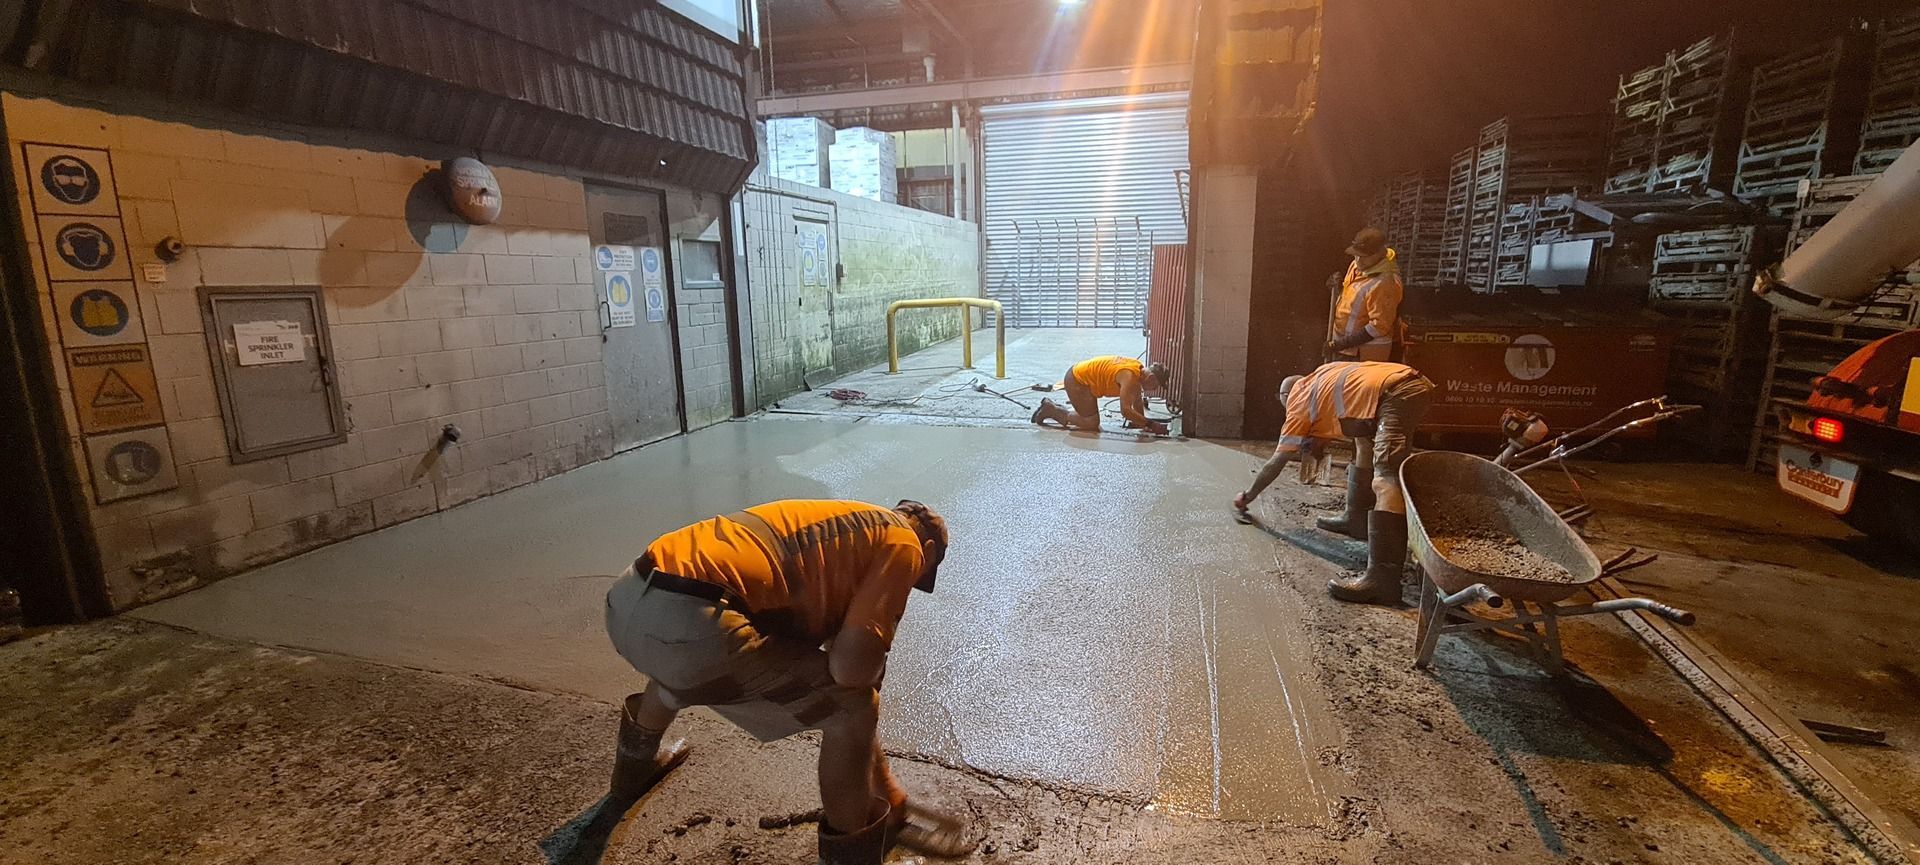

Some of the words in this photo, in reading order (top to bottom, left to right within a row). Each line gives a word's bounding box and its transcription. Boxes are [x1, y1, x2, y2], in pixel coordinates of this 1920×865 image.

[247, 343, 295, 352] SPRINKLER
[75, 352, 142, 364] WARNING
[260, 351, 284, 359] INLET
[1446, 379, 1492, 393] Waste
[1497, 381, 1598, 397] Management
